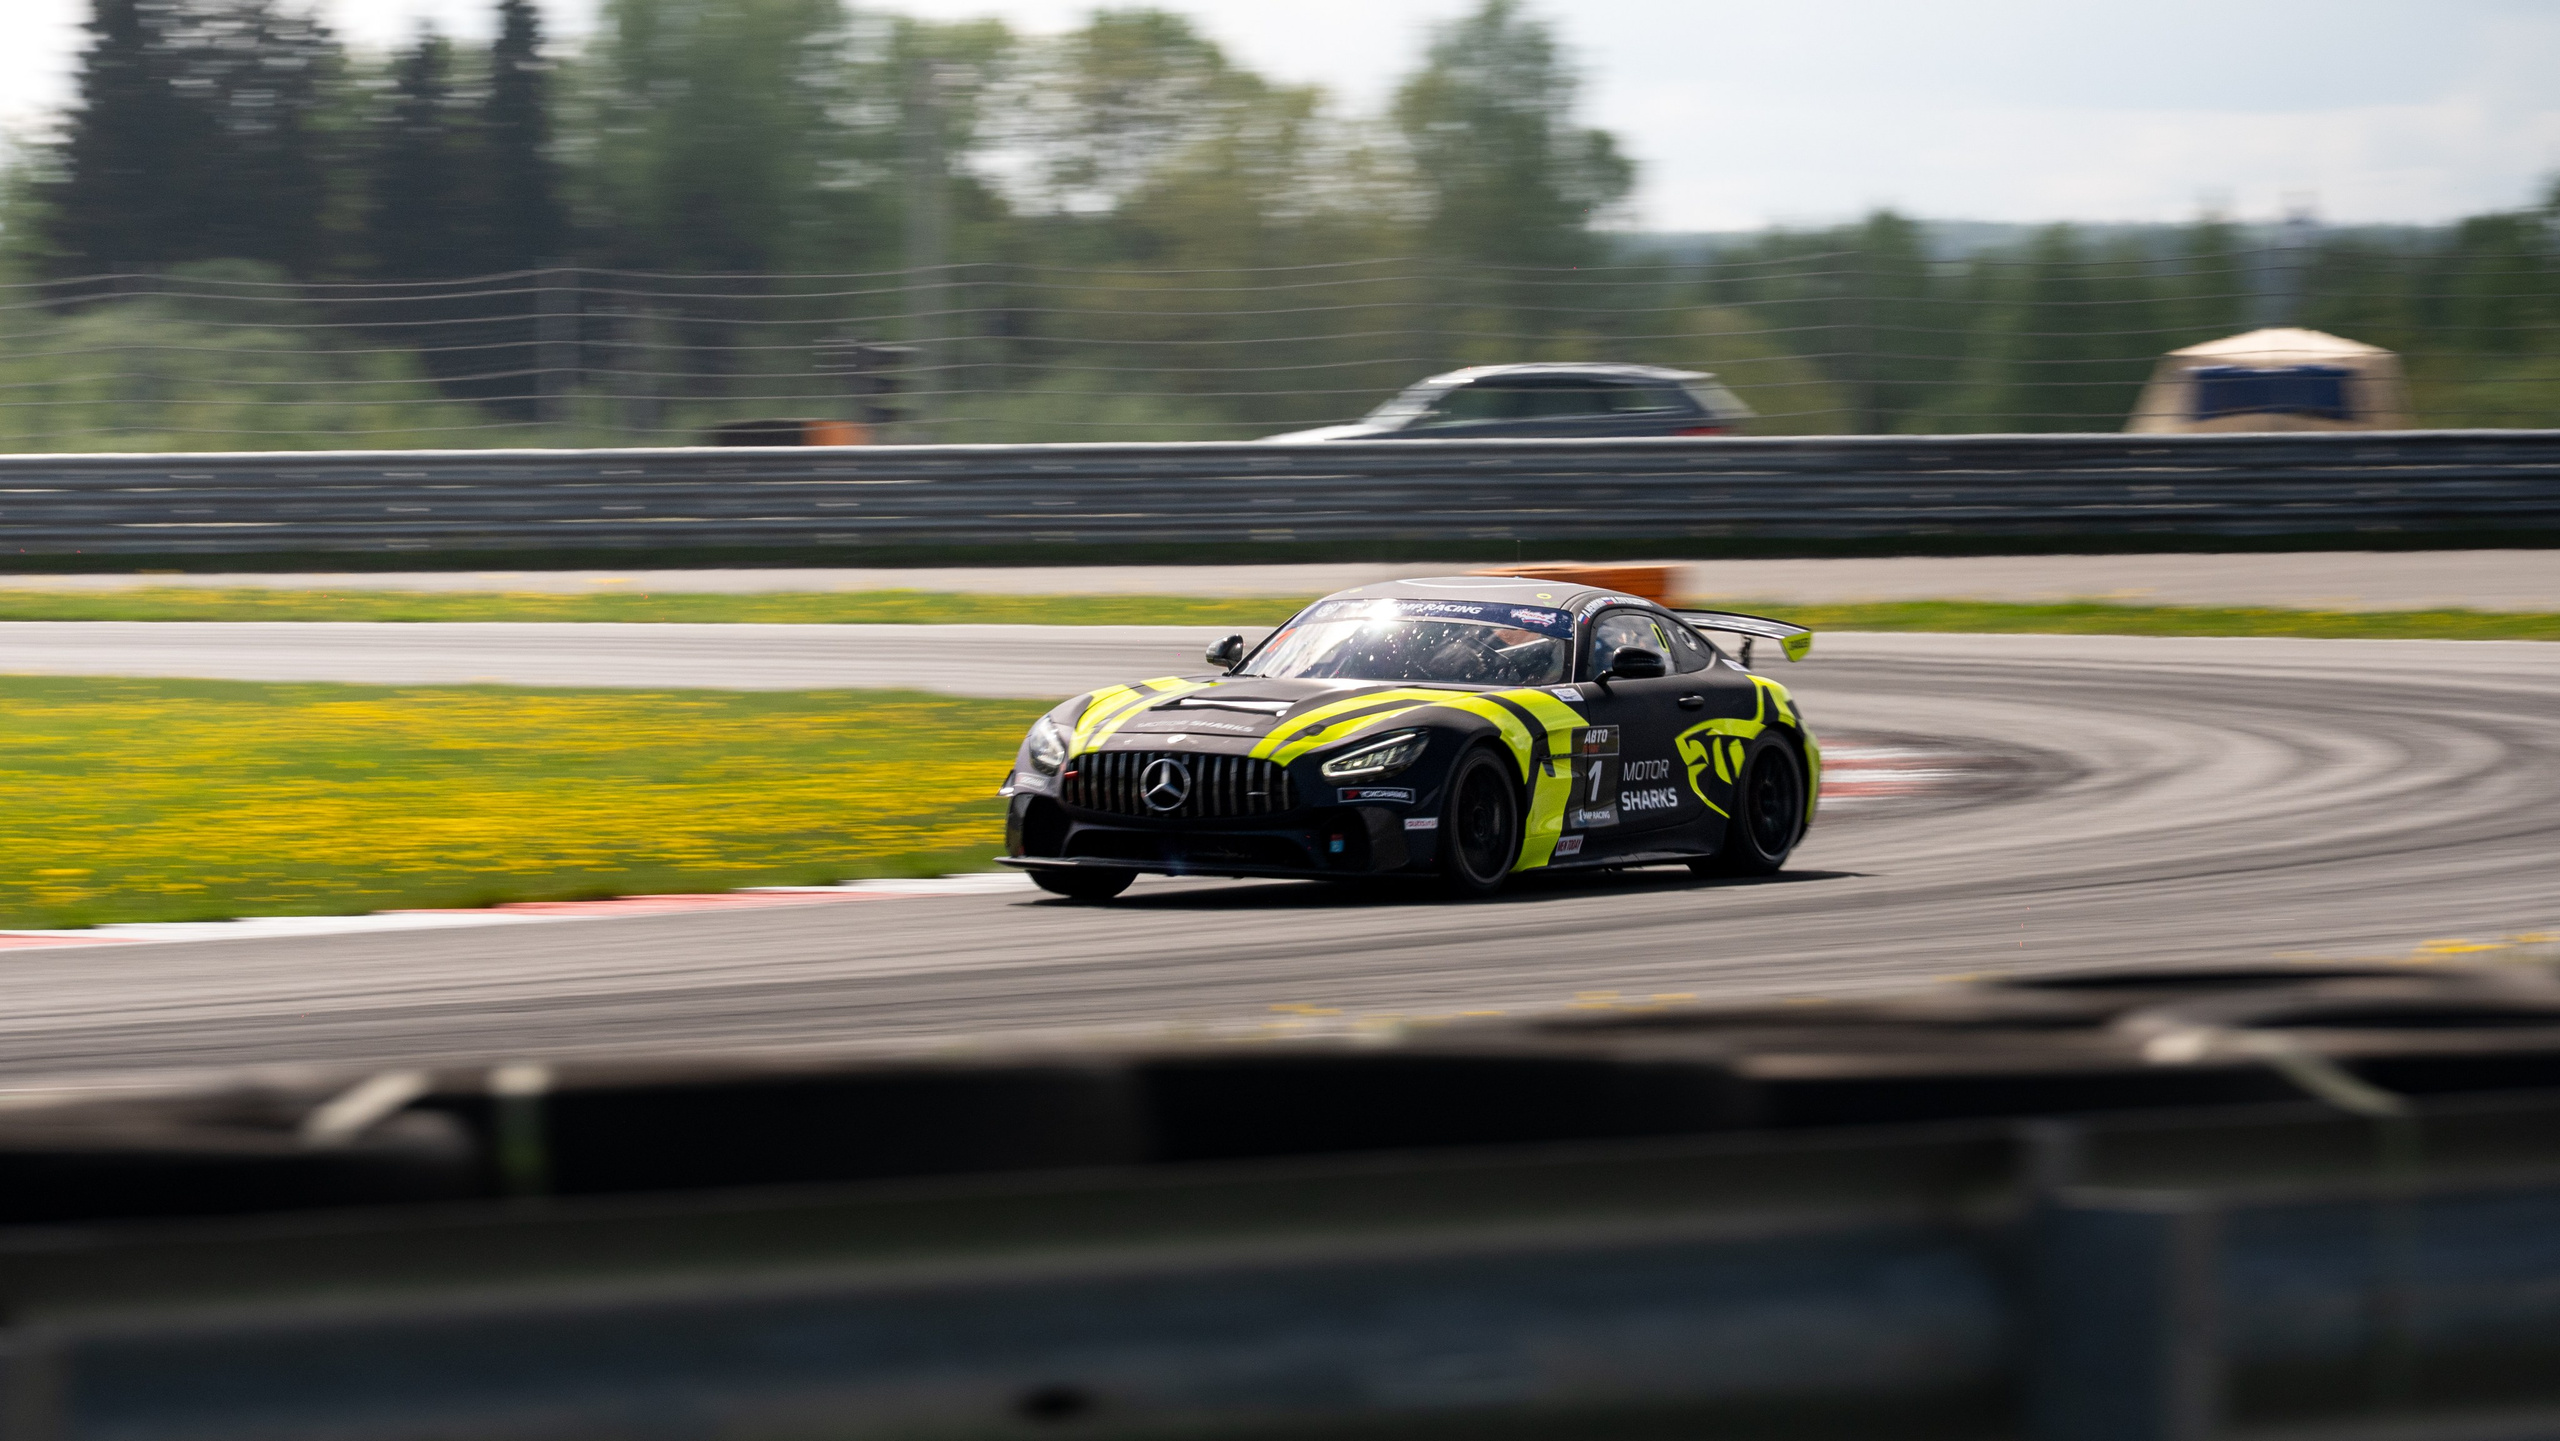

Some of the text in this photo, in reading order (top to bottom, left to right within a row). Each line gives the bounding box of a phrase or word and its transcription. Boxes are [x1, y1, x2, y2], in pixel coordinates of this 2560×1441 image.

[1423, 603, 1483, 614] RACING
[1189, 720, 1255, 733] SHARKS
[1584, 729, 1608, 744] АВТО
[1623, 759, 1669, 782] MOTOR
[1588, 760, 1602, 802] 1
[1621, 787, 1678, 811] SHARKS
[1593, 810, 1610, 819] RACING
